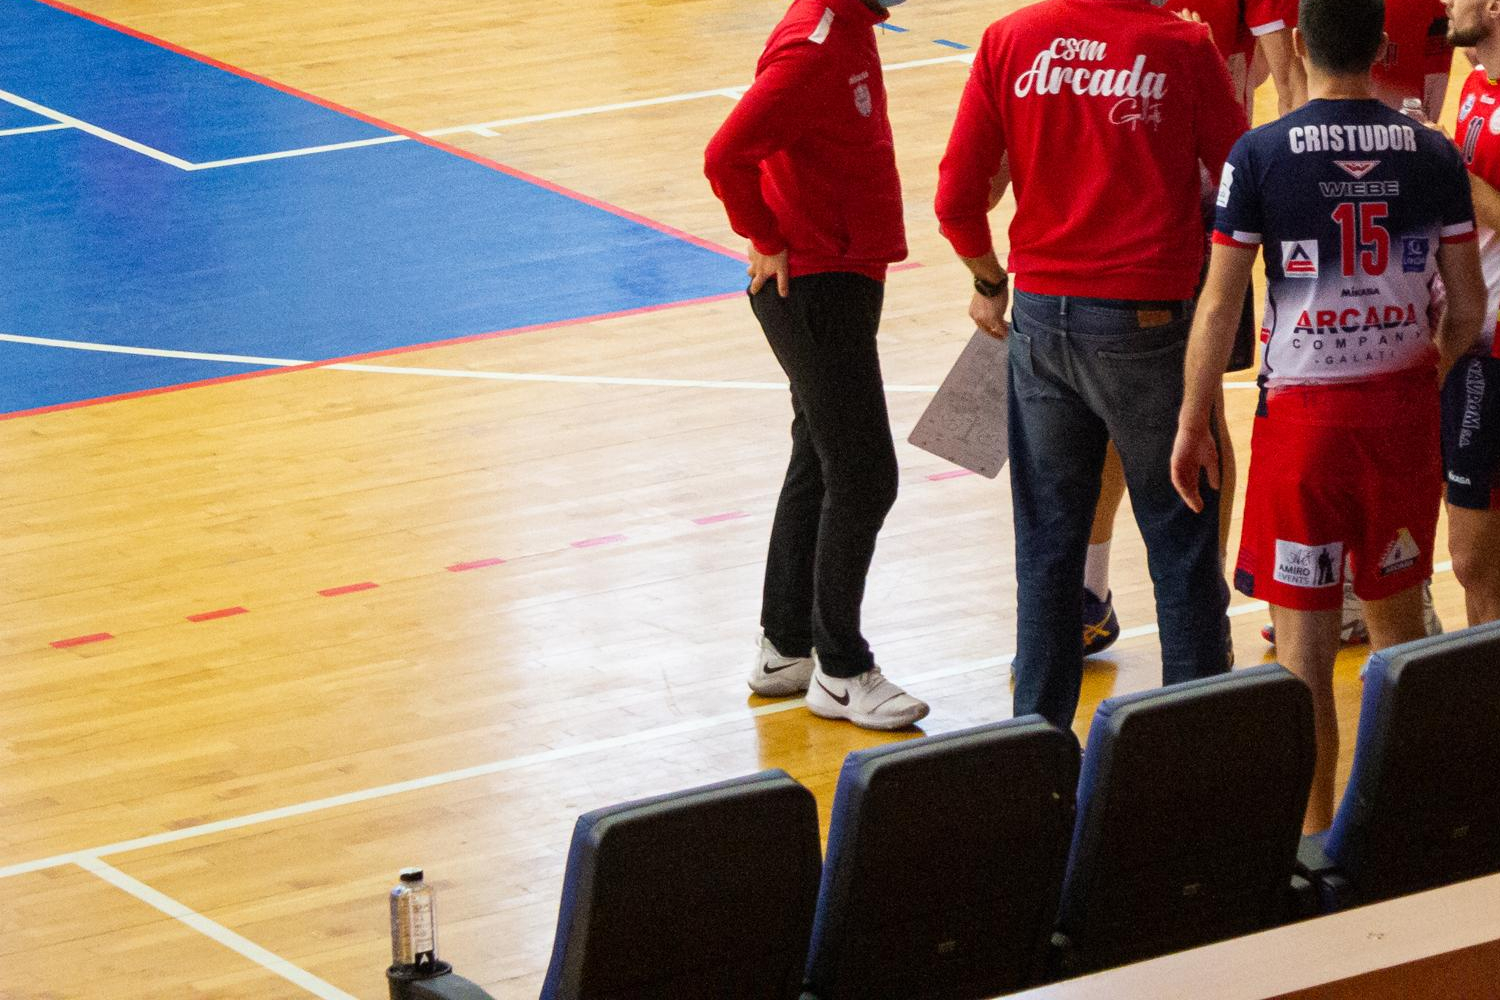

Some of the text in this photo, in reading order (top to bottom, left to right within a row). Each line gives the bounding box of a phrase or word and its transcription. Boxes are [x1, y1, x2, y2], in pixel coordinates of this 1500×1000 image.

[1050, 37, 1108, 61] csm
[1014, 49, 1168, 100] Arcada
[1288, 124, 1418, 154] CRISTUDOR
[1319, 180, 1400, 198] WIEBE
[1331, 201, 1391, 277] 15
[1293, 302, 1418, 336] ARCADA
[1292, 330, 1421, 351] COMPANY
[1279, 563, 1311, 577] AMIRO
